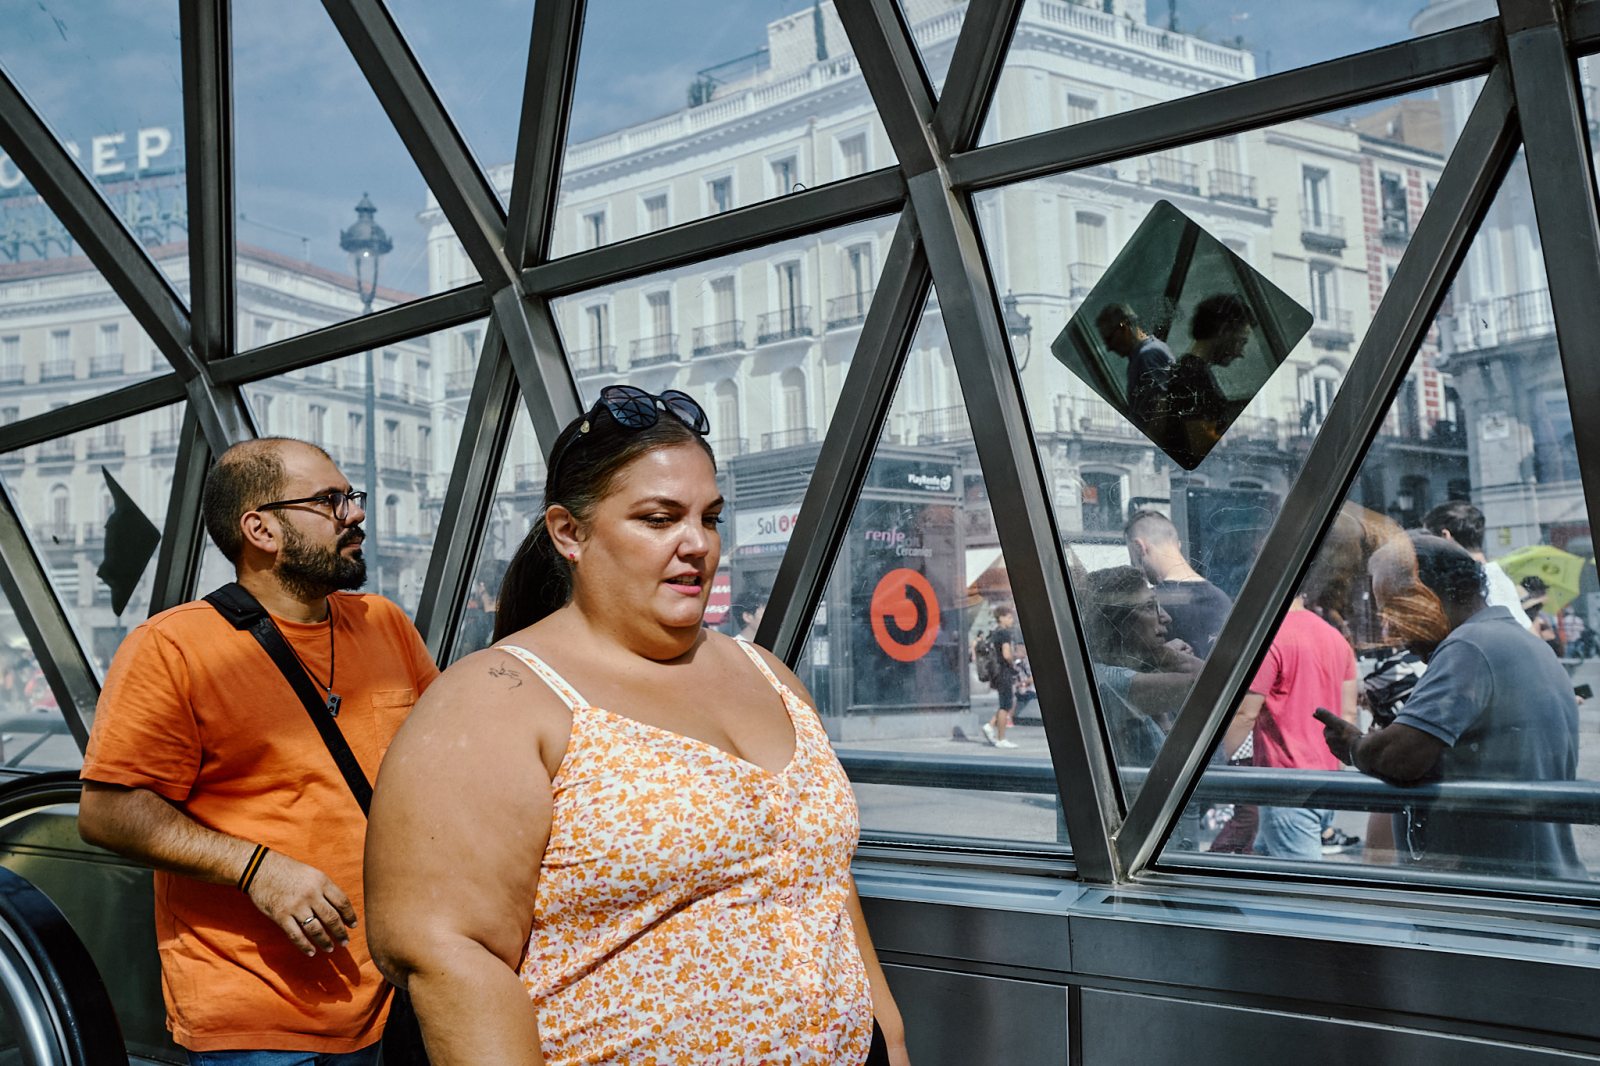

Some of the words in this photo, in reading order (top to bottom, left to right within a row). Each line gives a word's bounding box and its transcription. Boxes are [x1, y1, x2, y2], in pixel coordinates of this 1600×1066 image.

[66, 127, 172, 176] EP
[757, 515, 777, 535] Sol
[865, 526, 906, 549] renfe
